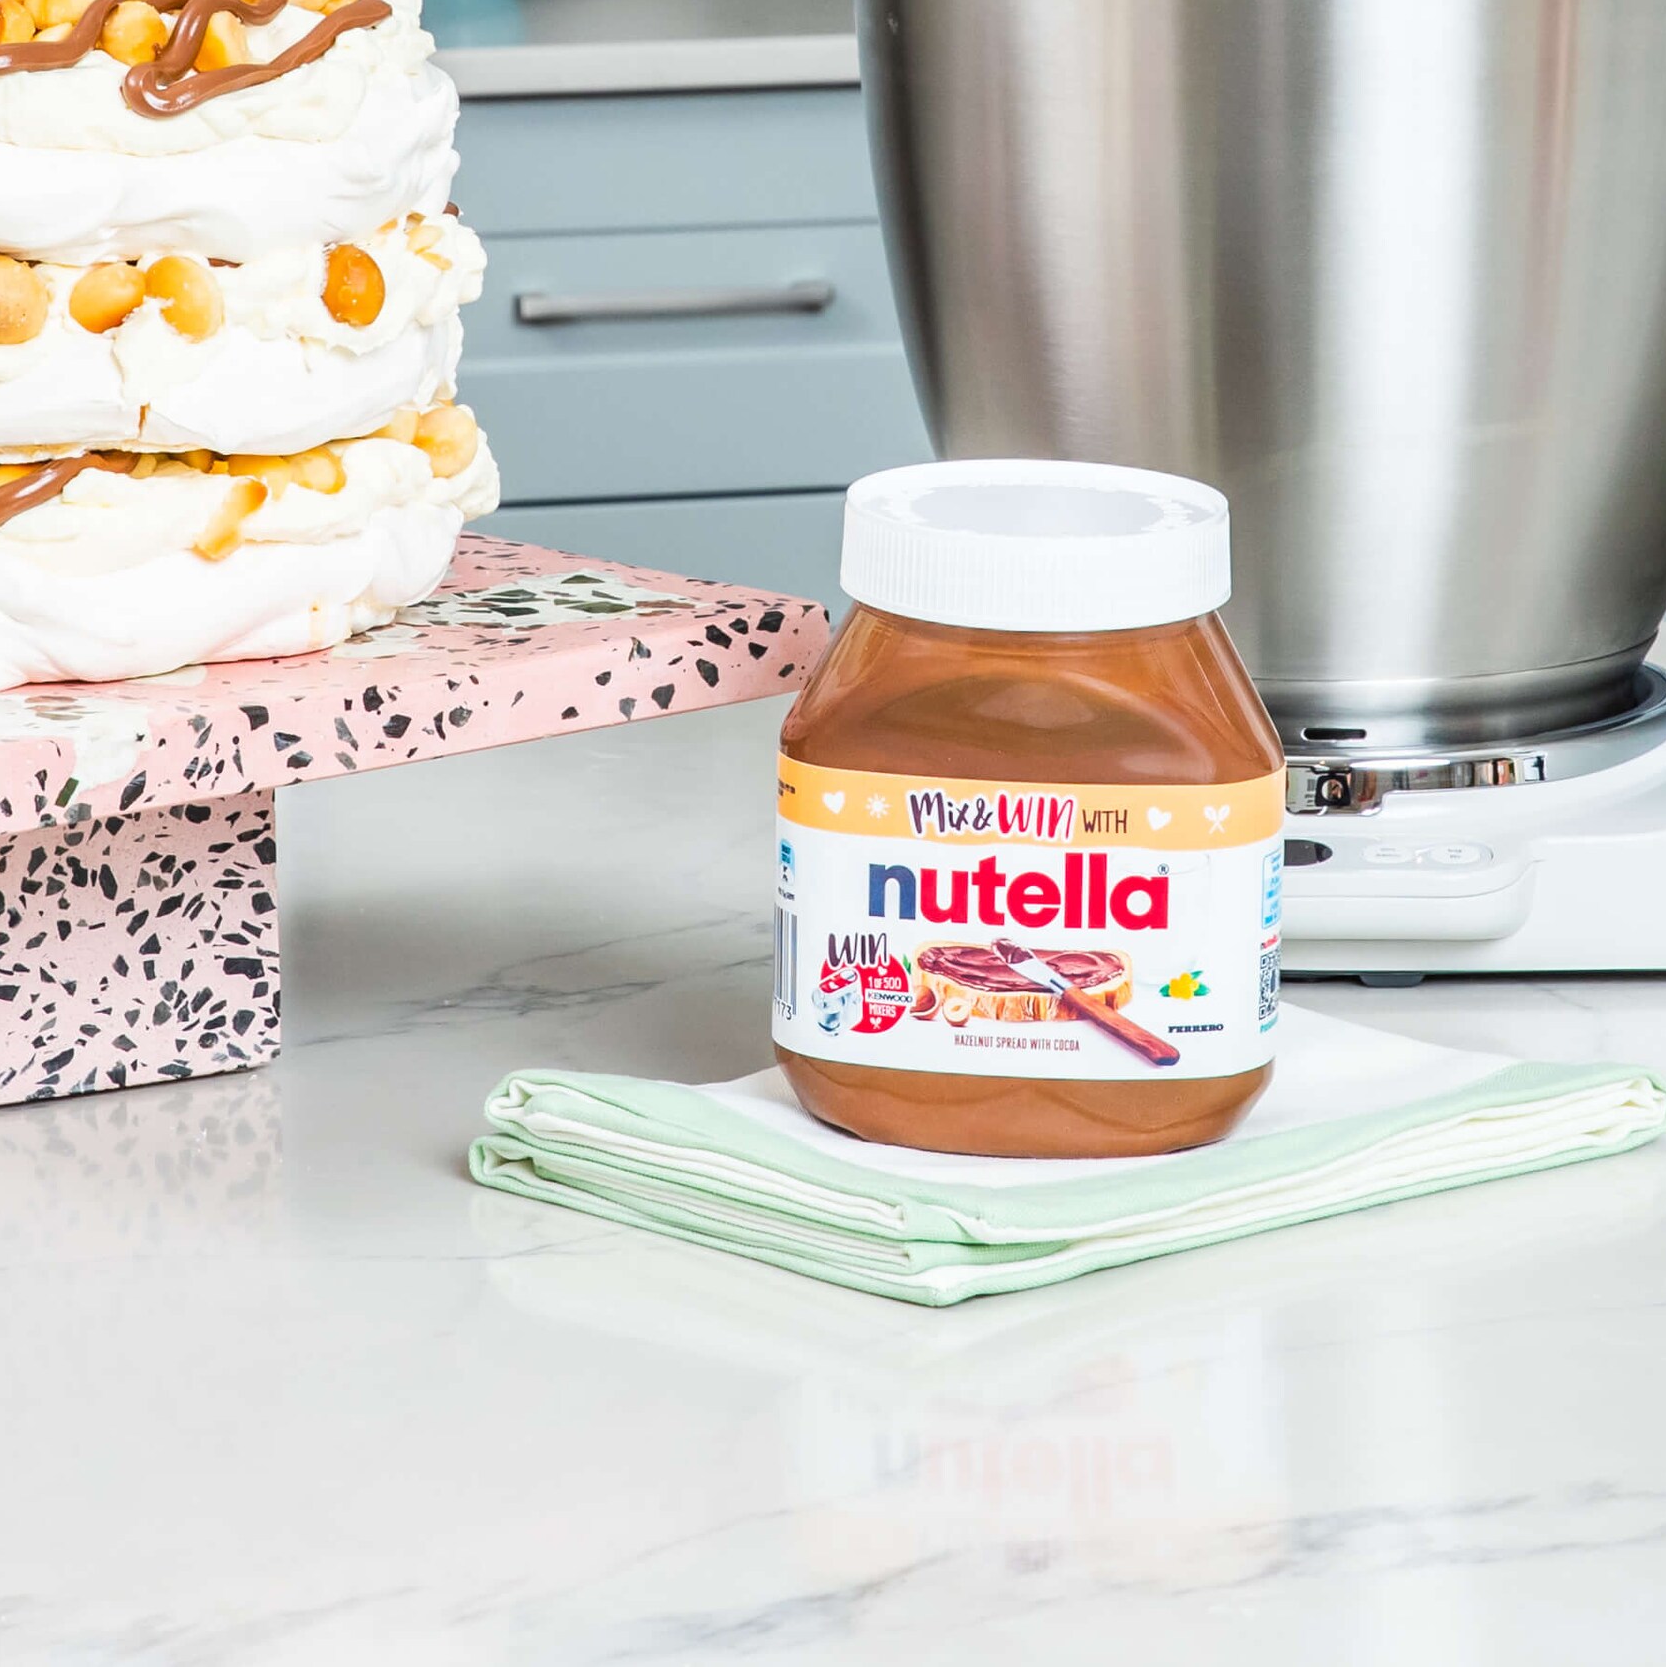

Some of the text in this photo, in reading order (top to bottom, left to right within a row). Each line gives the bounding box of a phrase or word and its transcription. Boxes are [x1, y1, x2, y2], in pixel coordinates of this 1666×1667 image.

[1082, 809, 1128, 834] WITH
[828, 933, 889, 967] WIN
[884, 977, 902, 990] 500
[867, 991, 913, 1004] KENWOOD
[869, 1004, 897, 1018] MIXERS
[1168, 1023, 1224, 1033] FERRERO
[954, 1034, 1080, 1052] HAZELNUT SPREAD WITH COCOA
